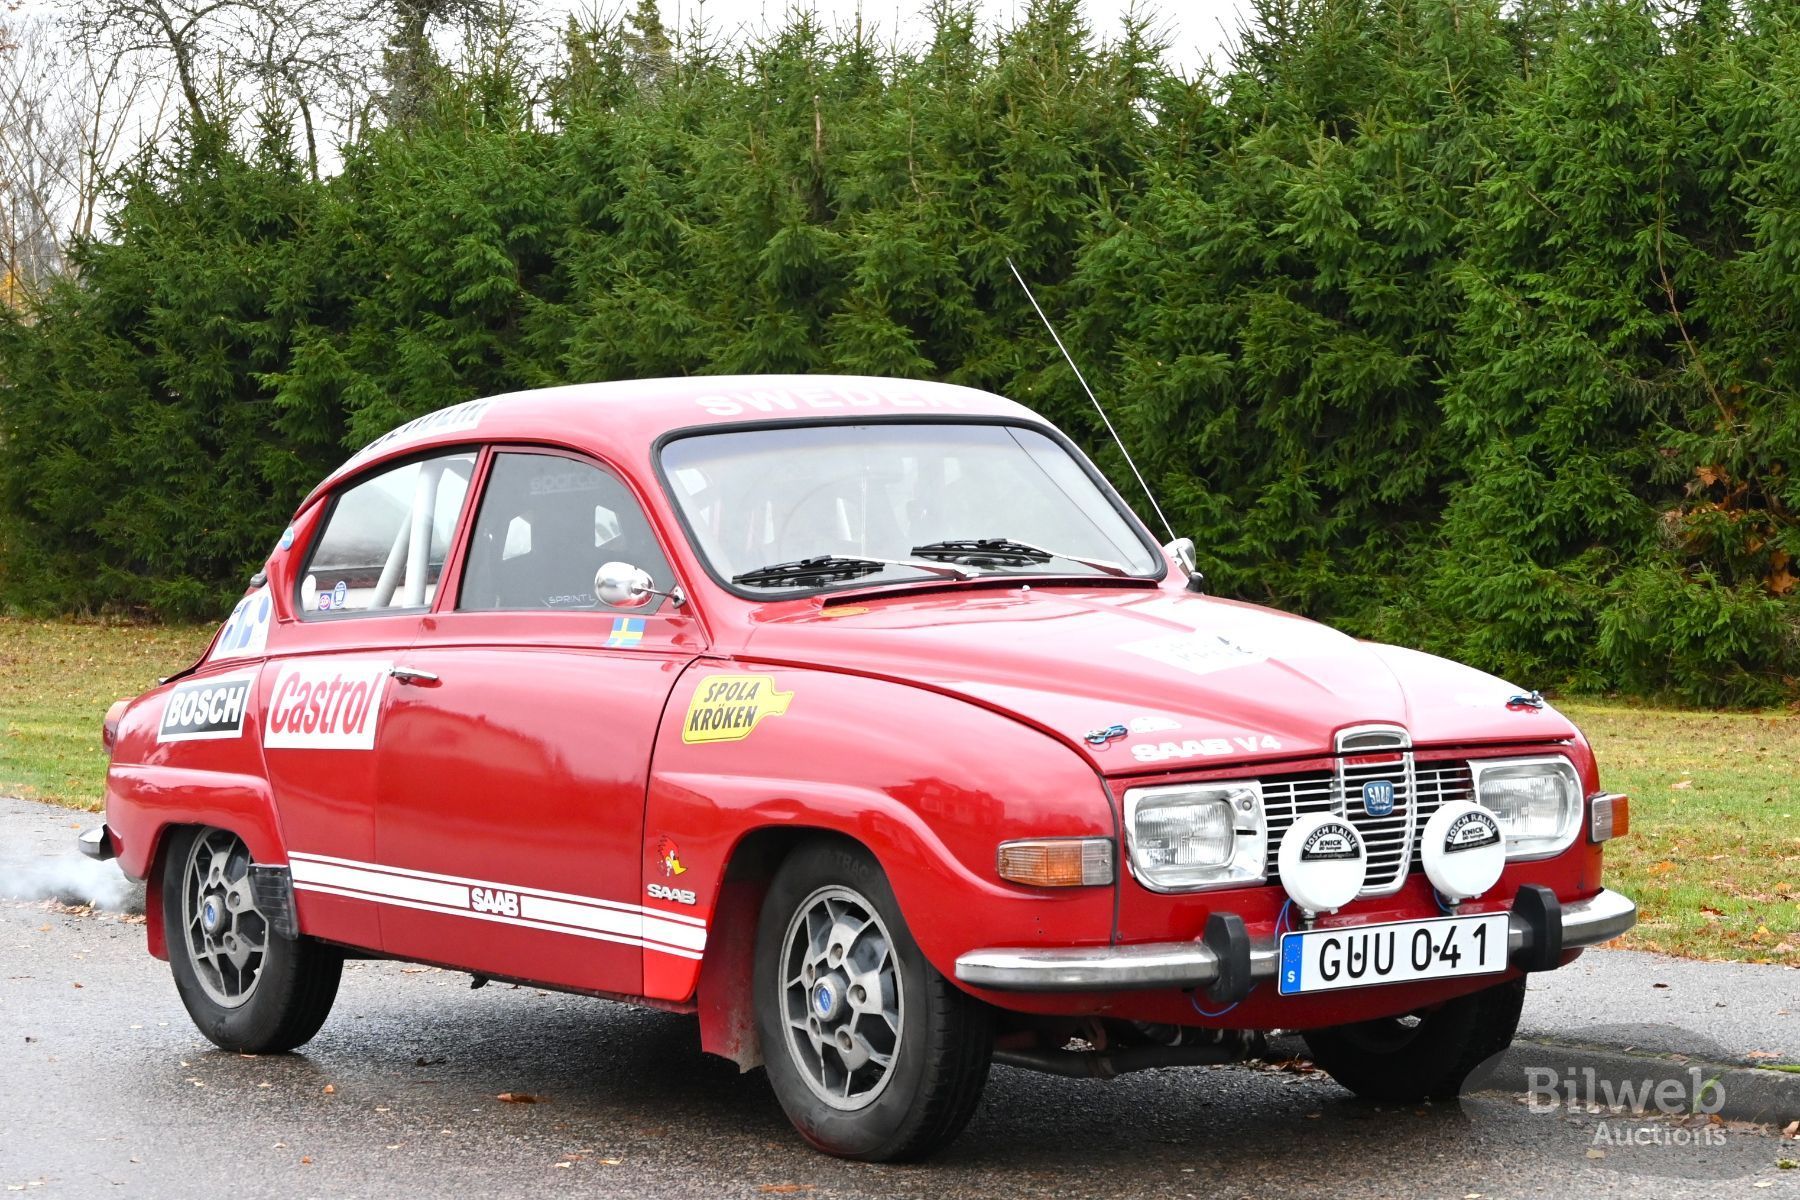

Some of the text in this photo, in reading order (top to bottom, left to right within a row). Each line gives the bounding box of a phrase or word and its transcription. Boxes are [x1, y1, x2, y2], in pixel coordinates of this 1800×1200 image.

[695, 387, 966, 416] SWEDEN
[547, 594, 588, 604] SPRINT
[270, 671, 383, 735] Castrol
[703, 682, 760, 702] SPOLA
[165, 686, 246, 728] BOSCH
[689, 704, 758, 732] KRÖKEN
[1131, 735, 1282, 762] SAAB V4
[1367, 785, 1390, 805] SAAB
[1304, 825, 1358, 851] BOSCH RALLYE
[1447, 814, 1497, 843] BOSCH RALLYE
[1462, 826, 1484, 836] KNICK
[1320, 839, 1343, 847] KNICK
[471, 887, 518, 917] SAAB
[647, 883, 697, 905] SAAB
[1319, 922, 1487, 982] GUU 041
[1287, 970, 1296, 983] S
